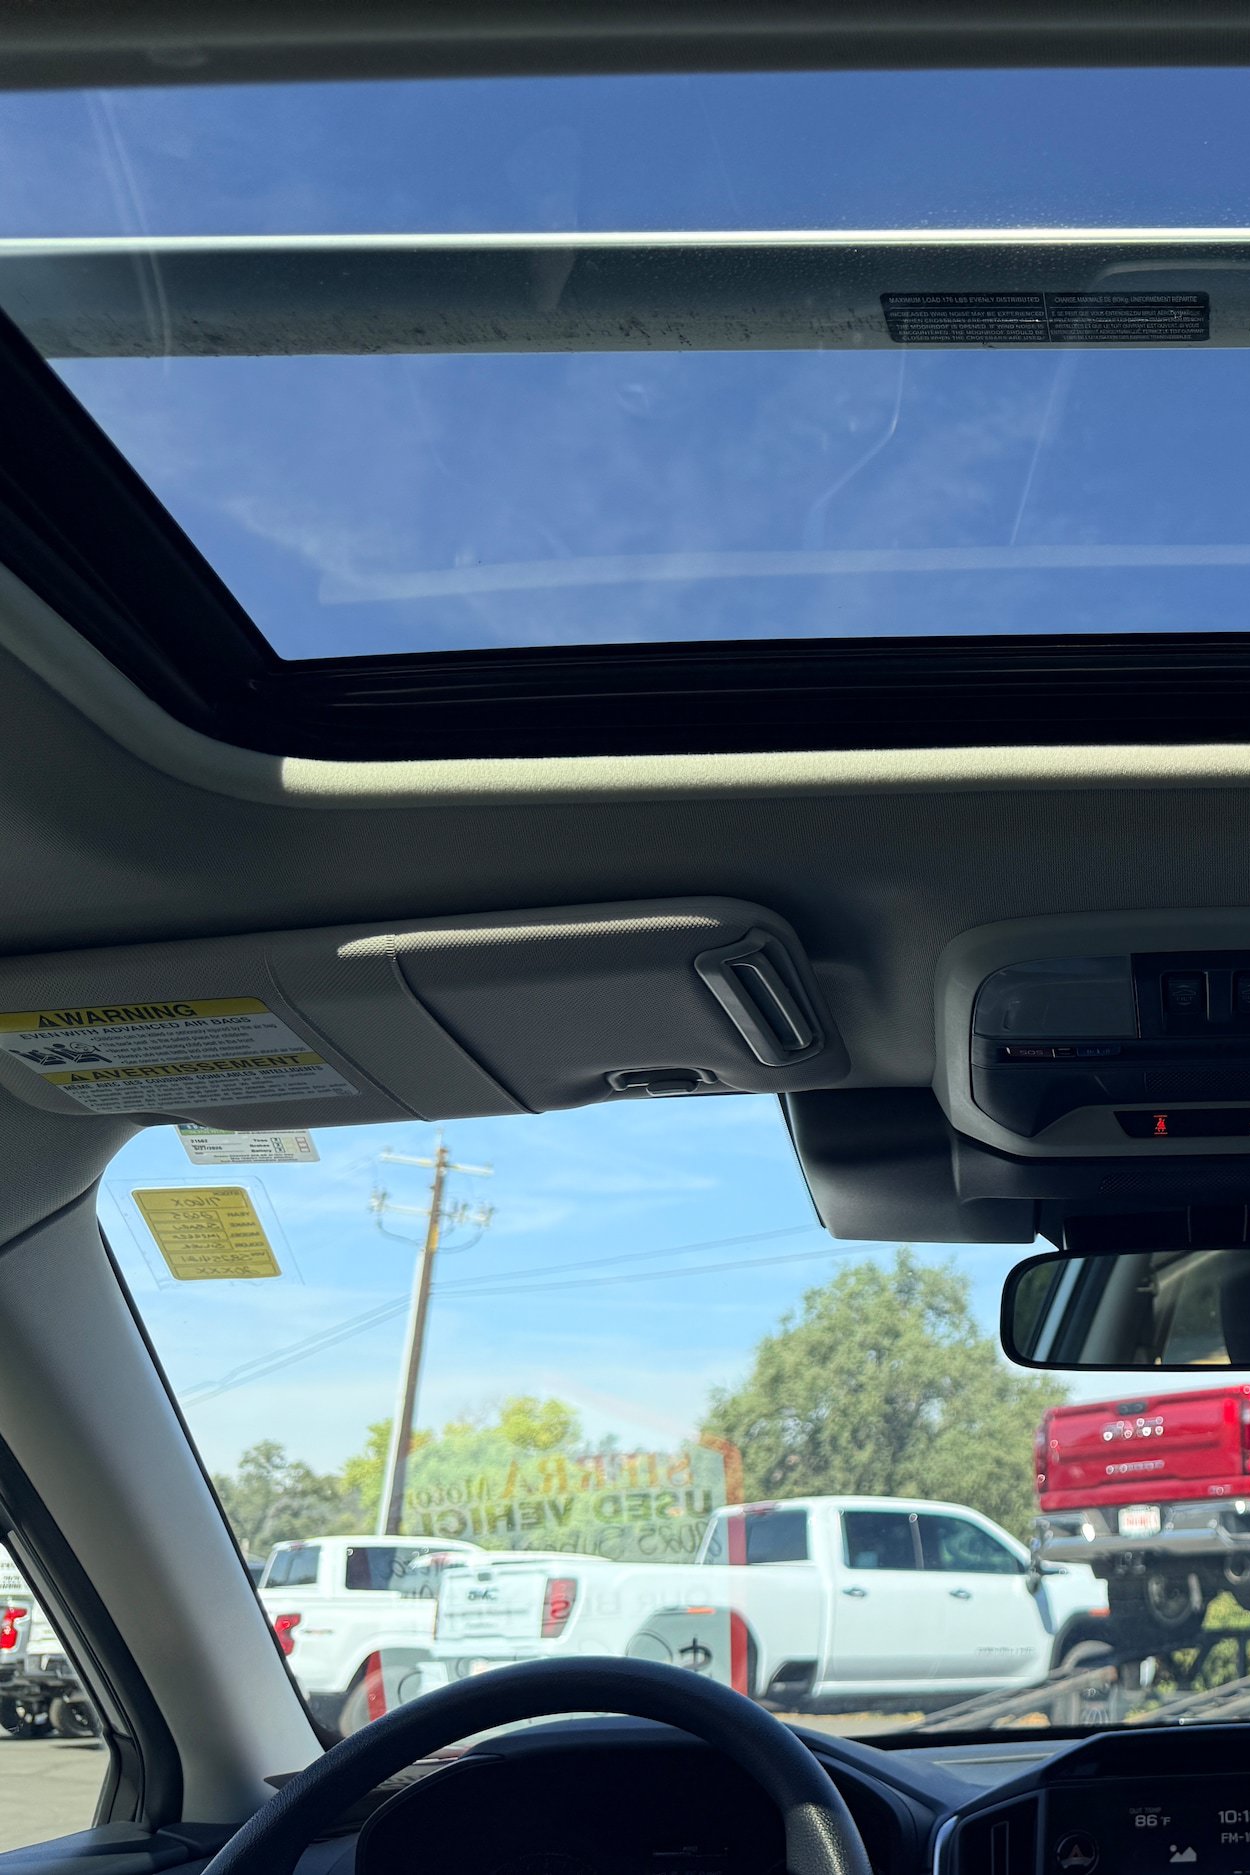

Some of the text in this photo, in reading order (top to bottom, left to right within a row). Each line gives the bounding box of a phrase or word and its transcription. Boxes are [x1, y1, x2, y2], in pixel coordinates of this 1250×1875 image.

[55, 1004, 198, 1026] WARNING
[21, 1016, 251, 1040] EVEN WITH ADVANCED AIR BAGS
[92, 1055, 300, 1080] AVERTISSEMENT
[1135, 1814, 1158, 1827] 86
